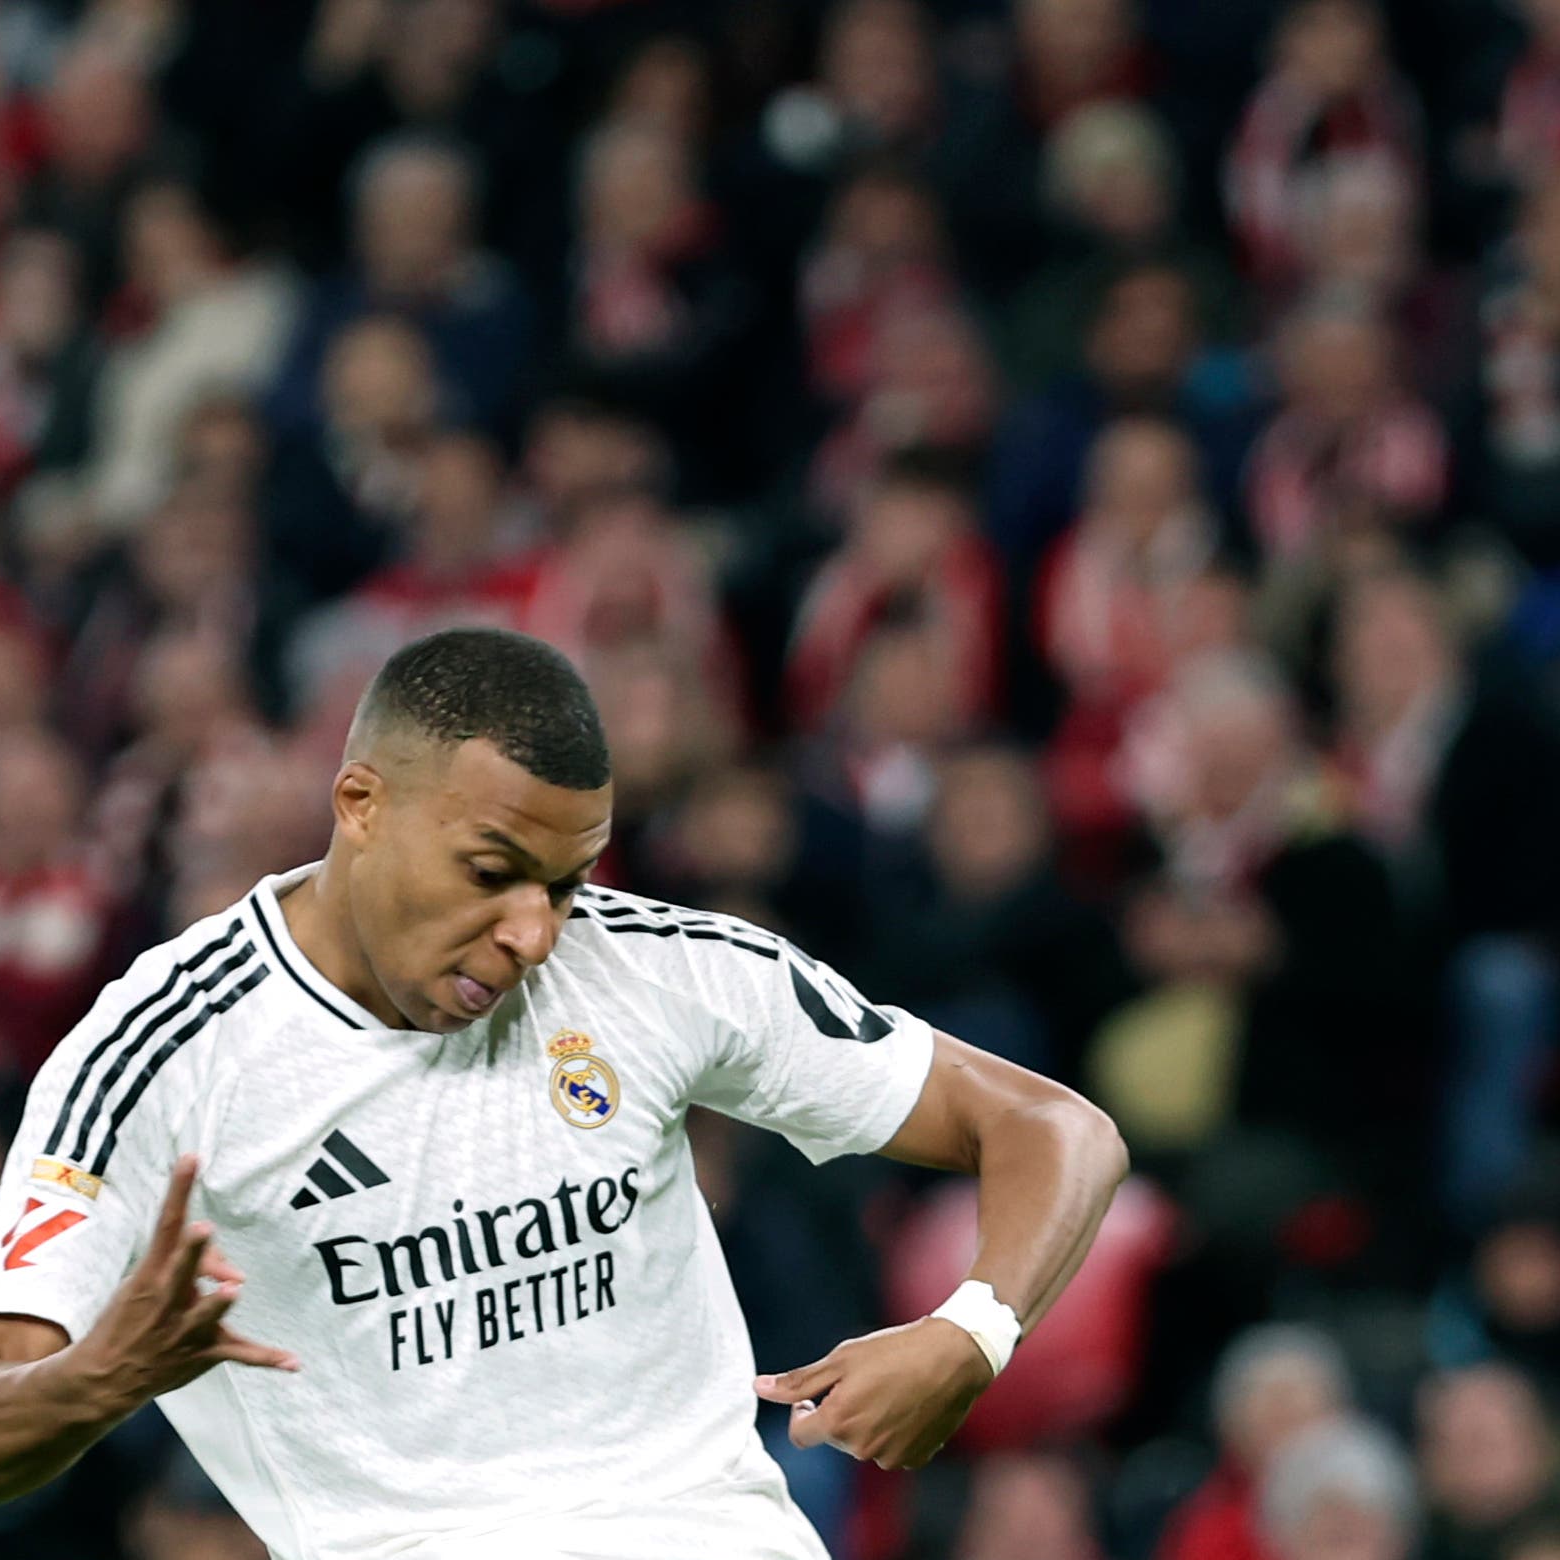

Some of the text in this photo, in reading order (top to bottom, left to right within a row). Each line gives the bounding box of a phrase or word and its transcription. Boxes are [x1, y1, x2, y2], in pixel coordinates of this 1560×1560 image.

[312, 1166, 639, 1305] Emirates
[390, 1250, 617, 1371] FLY BETTER
